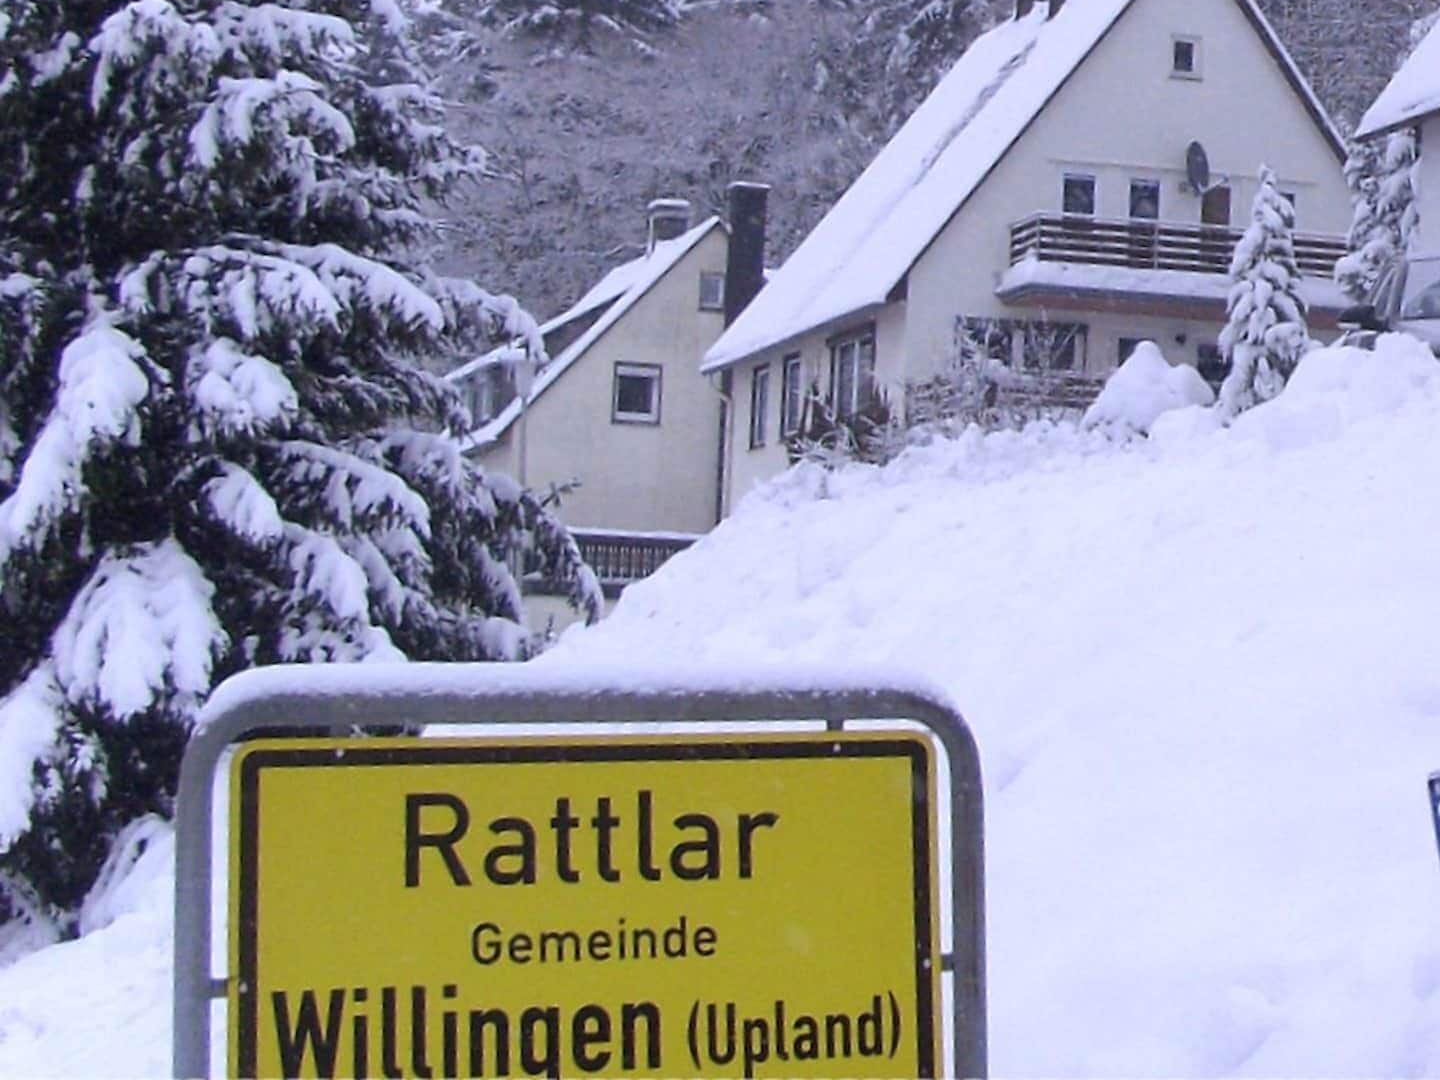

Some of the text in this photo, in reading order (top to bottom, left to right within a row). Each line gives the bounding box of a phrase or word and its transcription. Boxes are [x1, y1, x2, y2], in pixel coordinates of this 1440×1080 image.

[402, 790, 780, 888] Rattlar
[470, 916, 719, 966] Gemeinde
[271, 984, 903, 1080] Willingen (Upland)
